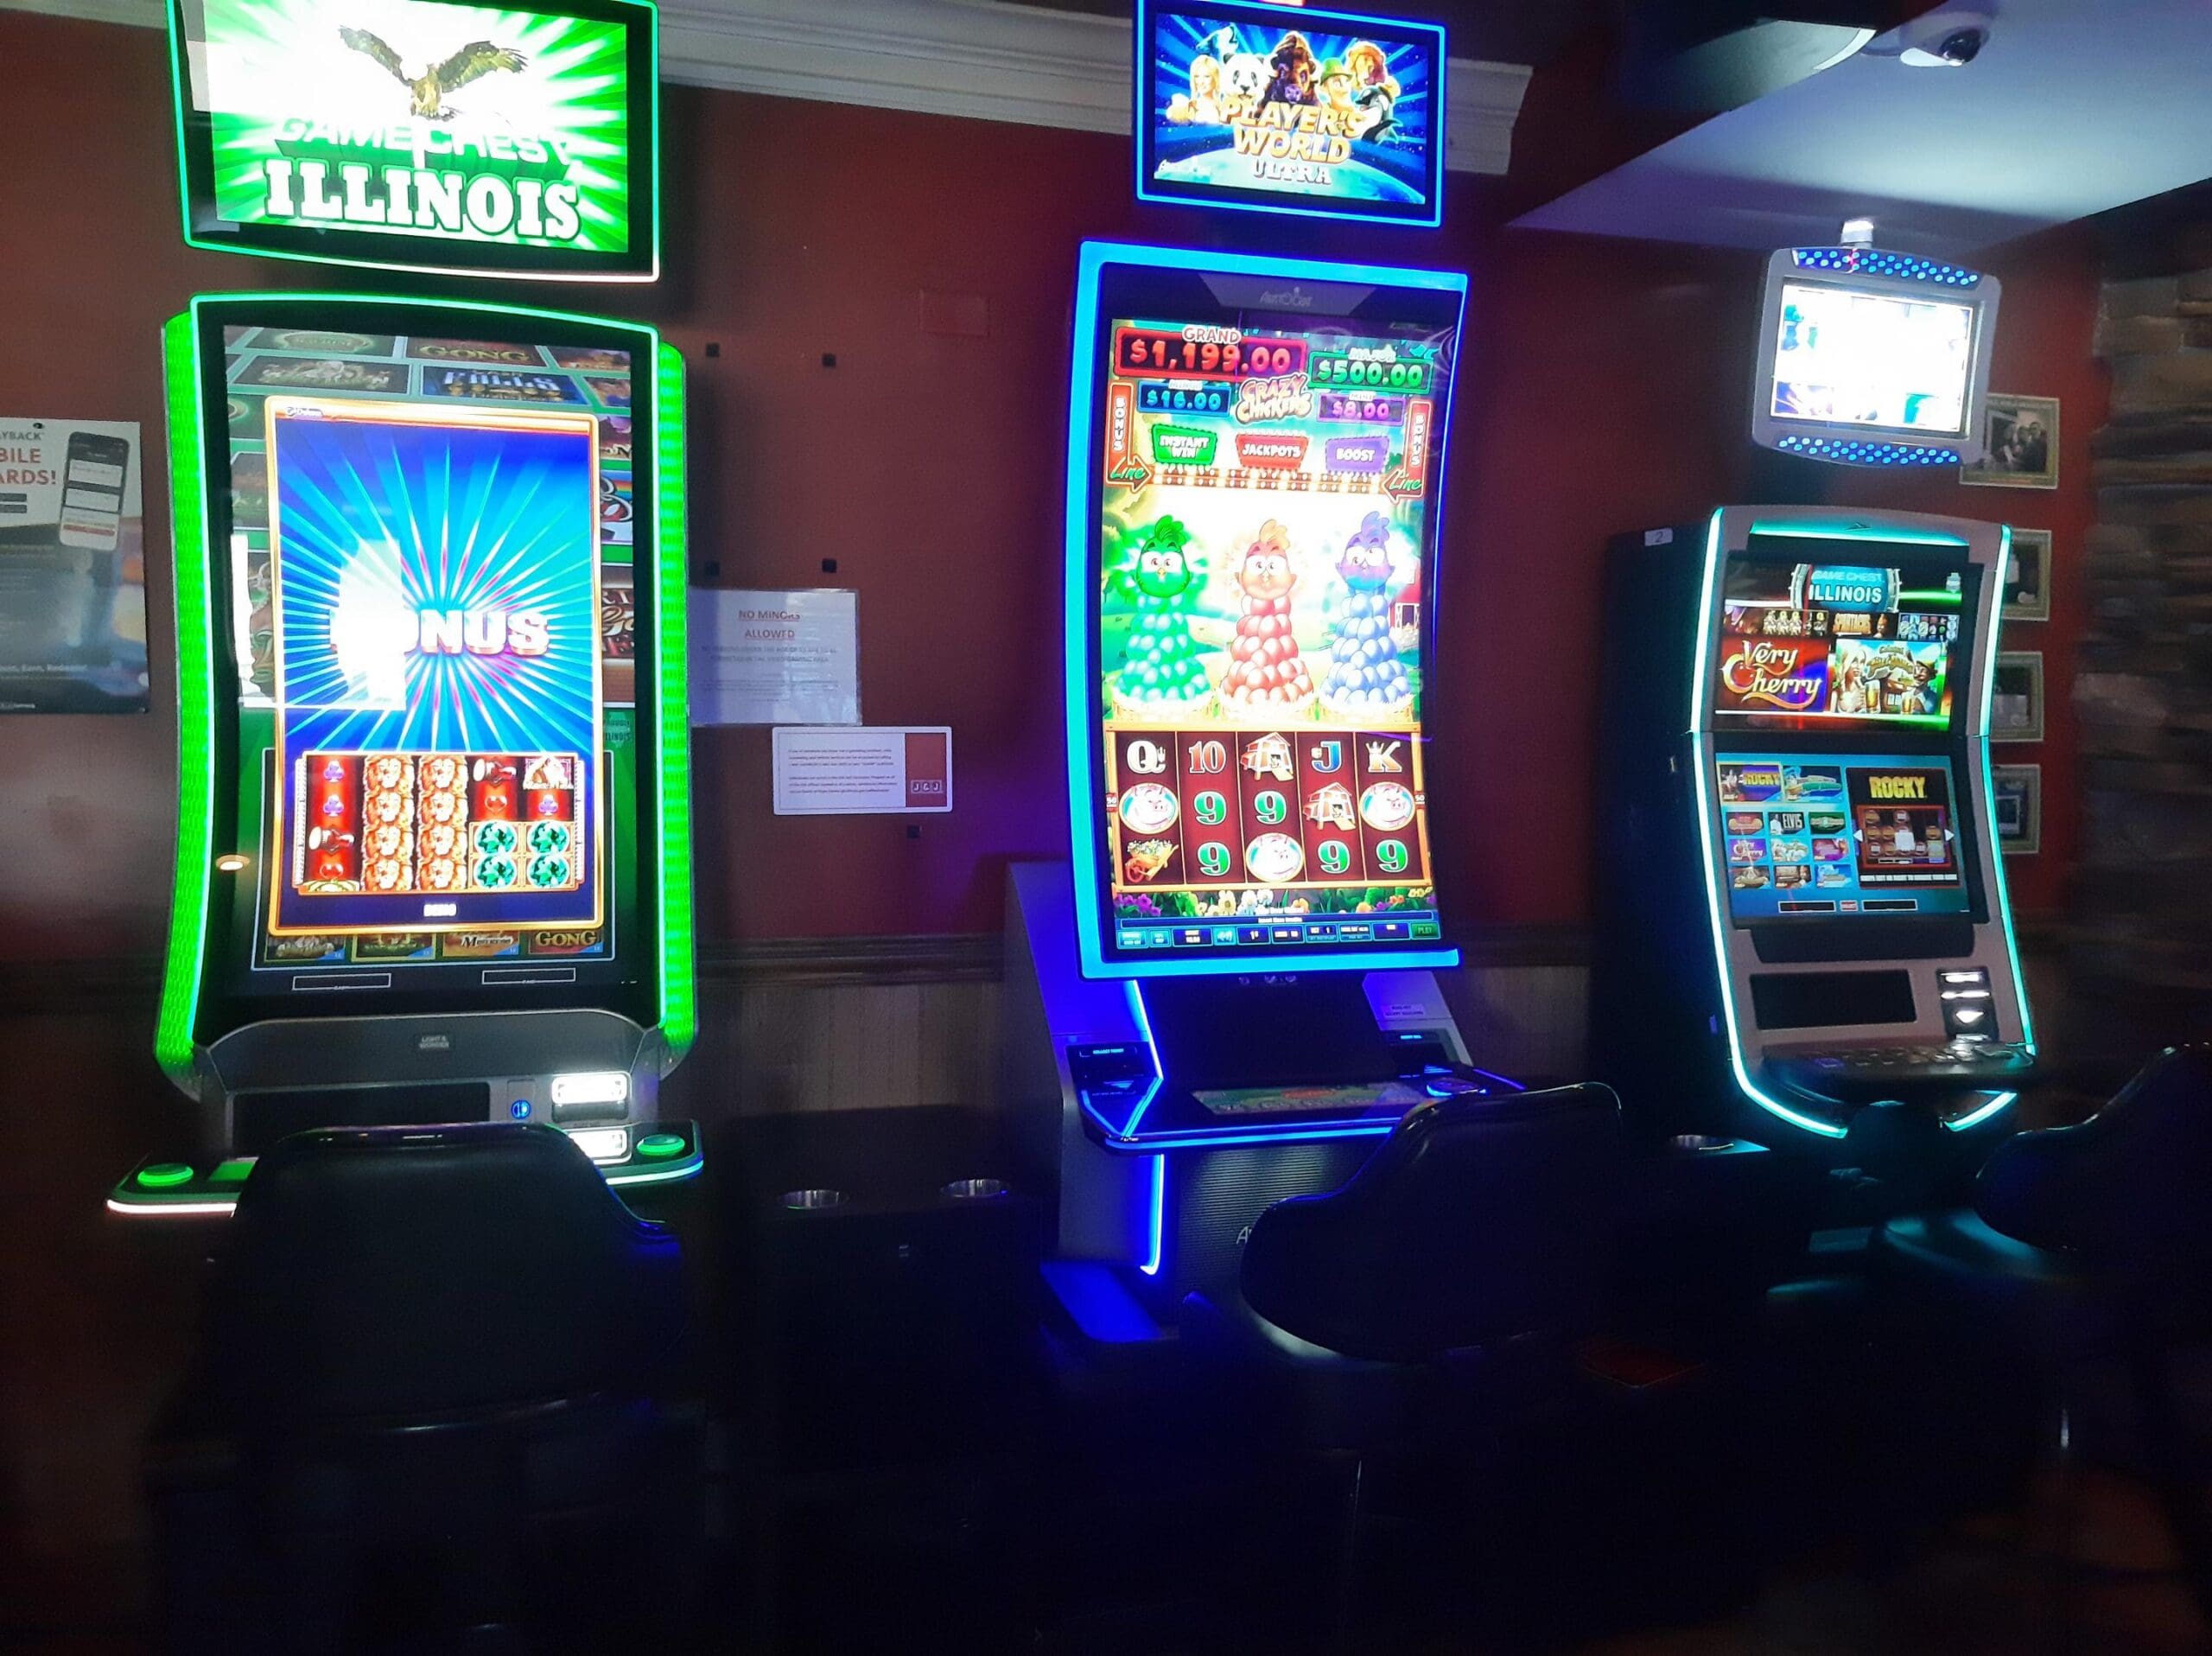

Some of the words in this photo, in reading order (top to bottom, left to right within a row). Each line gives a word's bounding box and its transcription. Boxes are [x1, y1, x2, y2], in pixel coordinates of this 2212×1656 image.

[1219, 97, 1372, 138] PLAYER'S
[278, 117, 412, 150] GAME
[1235, 129, 1352, 165] WORLD
[1253, 159, 1332, 185] ULTRA
[264, 158, 582, 241] ILLINOIS
[1182, 326, 1241, 344] GRAND
[1130, 338, 1291, 373] $1,199.00
[1318, 360, 1423, 387] $500.00
[1241, 374, 1307, 402] CRAZY
[1147, 390, 1221, 411] $16.00
[1332, 401, 1389, 419] $8.00
[1113, 397, 1126, 451] BONUS
[0, 431, 41, 441] YBACK
[1159, 435, 1210, 449] INSTANT
[1411, 415, 1424, 466] BONUS
[1171, 447, 1197, 458] WIN
[1242, 443, 1302, 458] JACKPOTS
[1336, 448, 1376, 462] BOOST
[1812, 571, 1844, 581] GAME
[1845, 572, 1883, 582] CHEST
[1808, 583, 1883, 604] ILLINOIS
[739, 610, 754, 620] NO
[1742, 640, 1798, 676] Very
[1719, 653, 1823, 709] Cherry
[1189, 741, 1226, 774] 10
[1868, 776, 1925, 799] ROCKY
[1783, 812, 1803, 830] ELVIS
[535, 930, 598, 947] GONG
